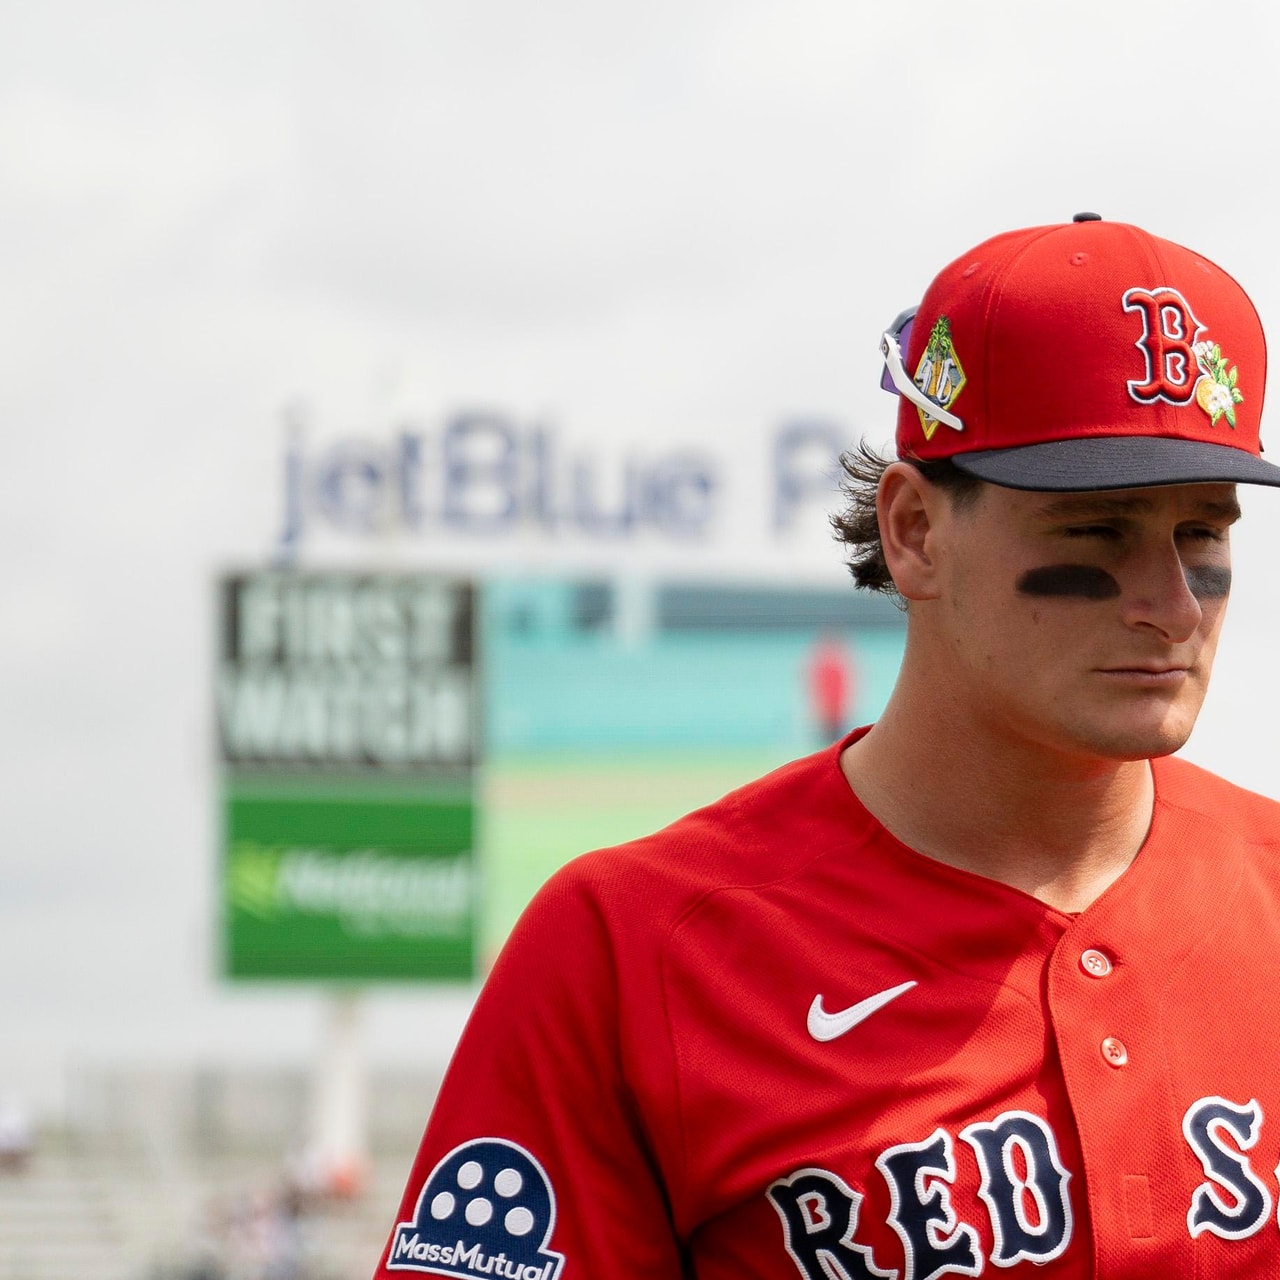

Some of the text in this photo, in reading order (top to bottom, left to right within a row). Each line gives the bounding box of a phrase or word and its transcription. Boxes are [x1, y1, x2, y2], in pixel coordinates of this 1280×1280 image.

[1121, 286, 1208, 407] B
[276, 404, 720, 568] jetBlue
[240, 577, 456, 662] FIRST
[221, 670, 472, 760] WATCH
